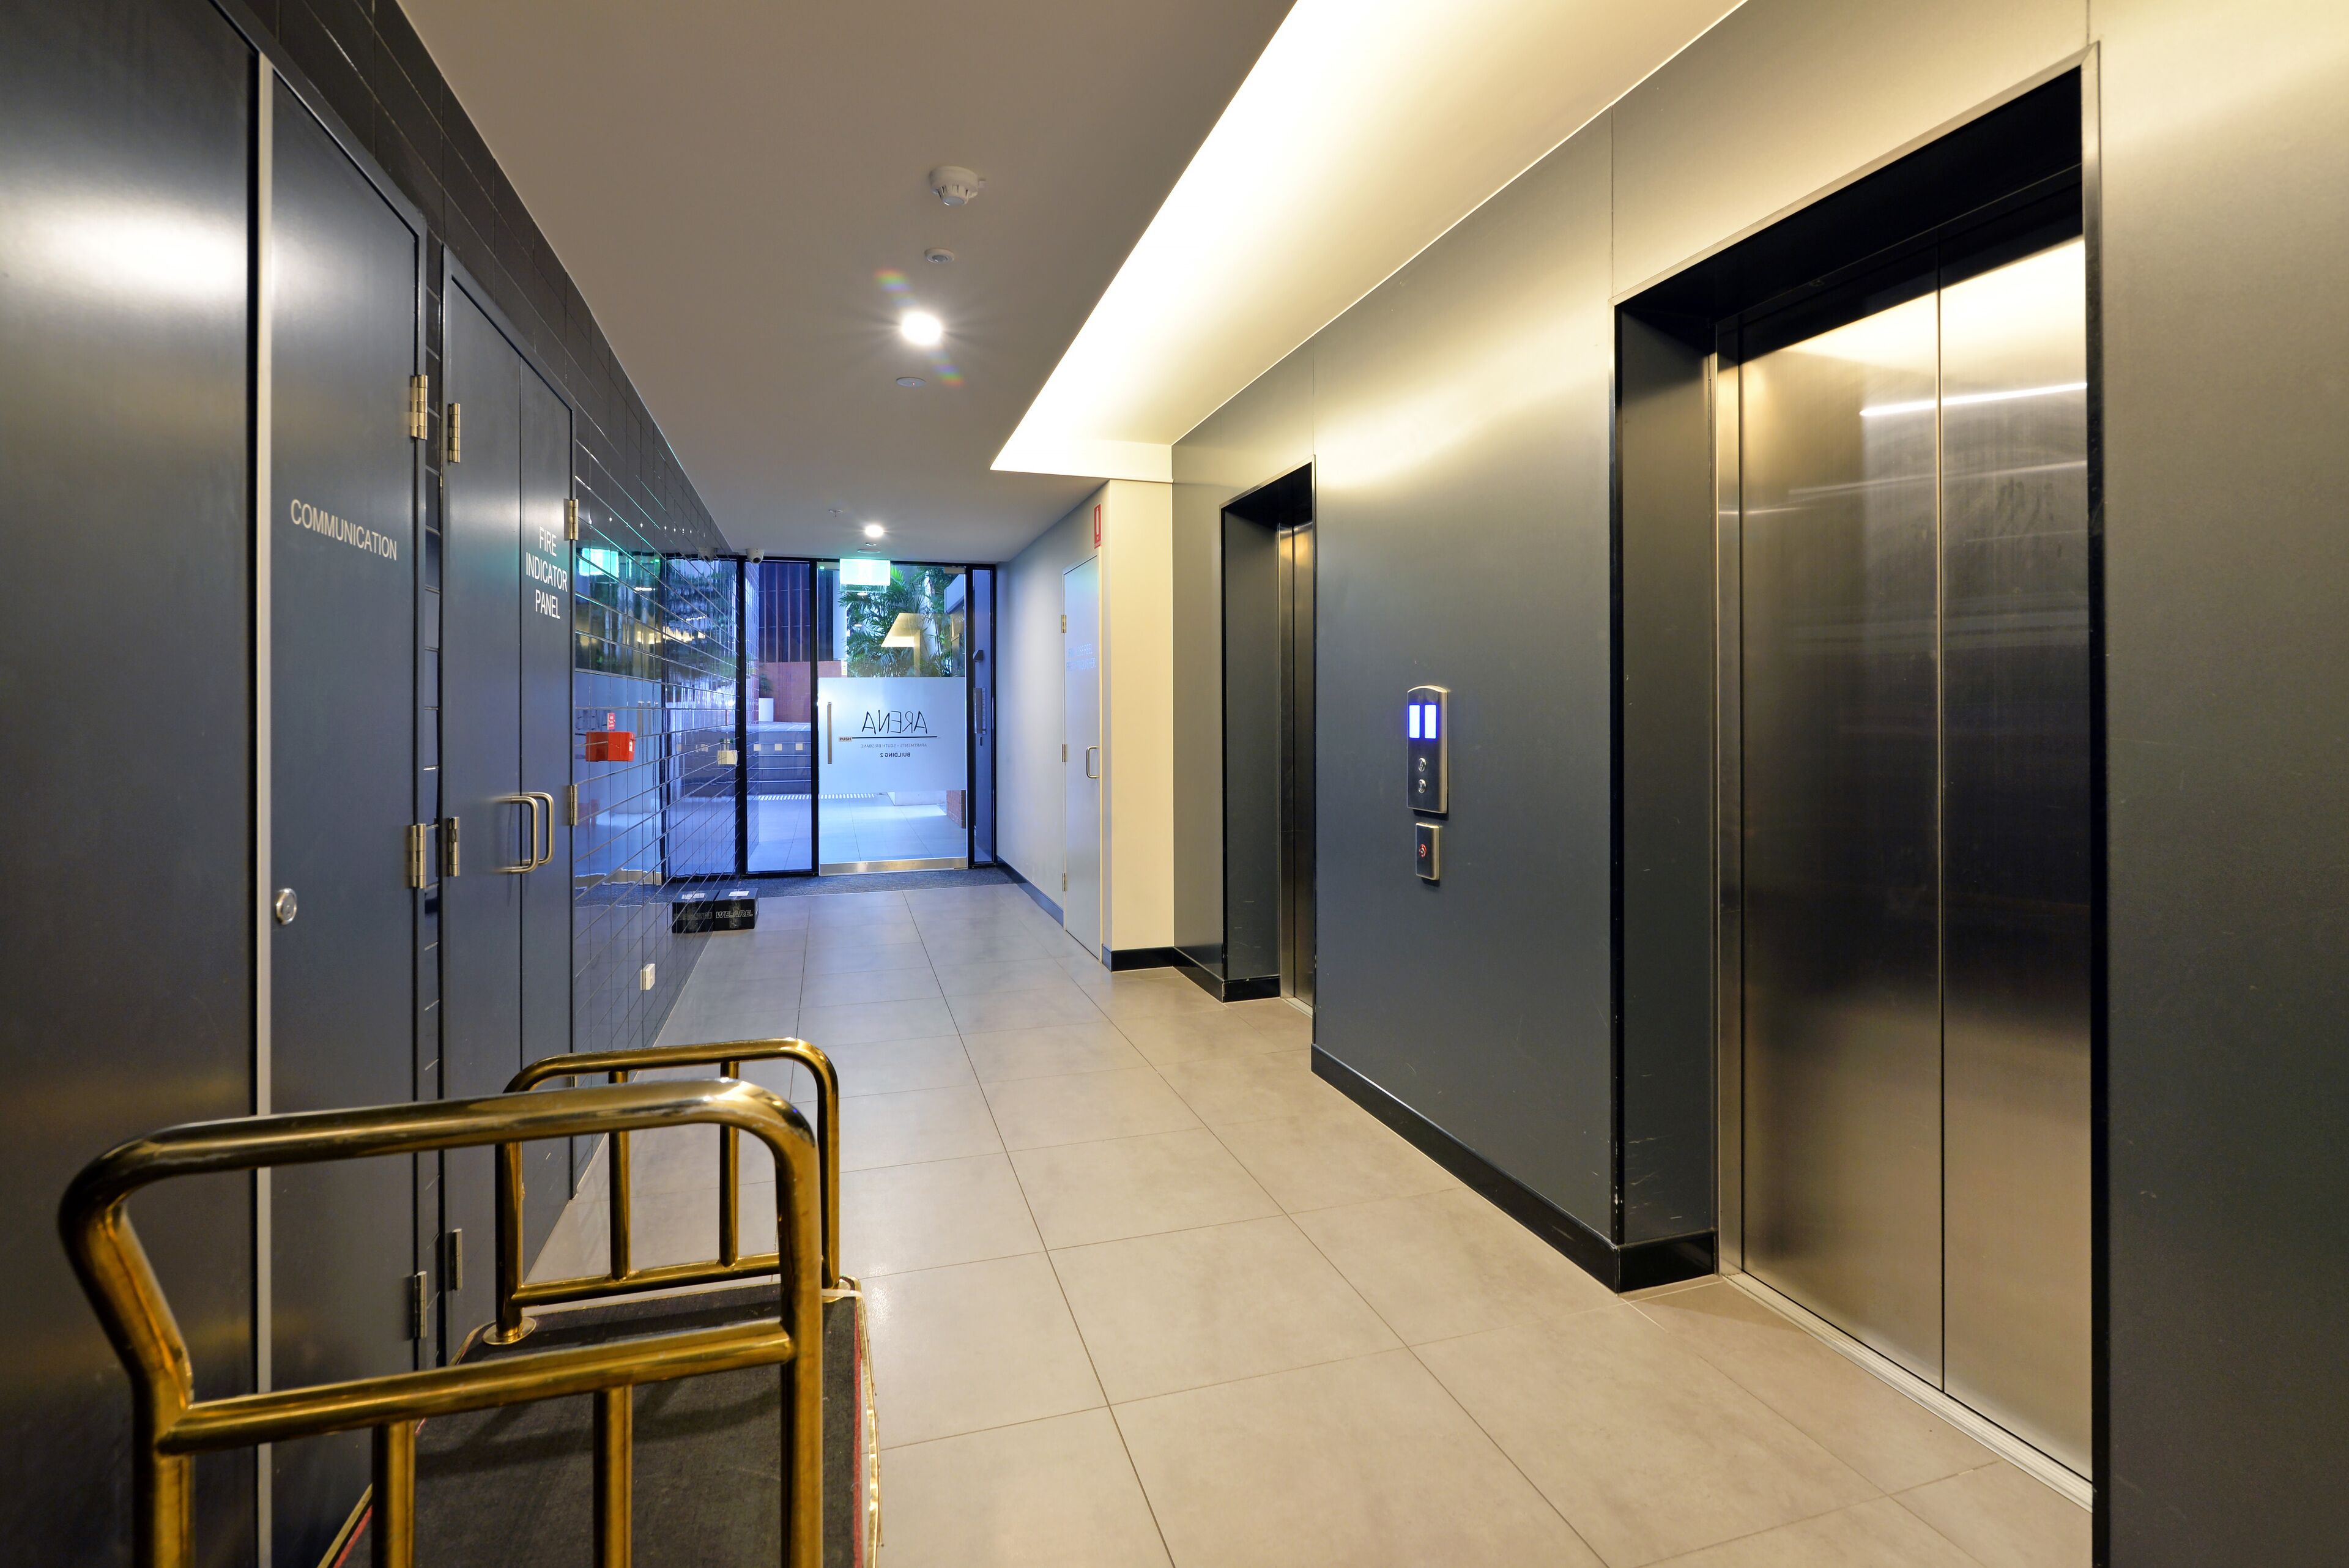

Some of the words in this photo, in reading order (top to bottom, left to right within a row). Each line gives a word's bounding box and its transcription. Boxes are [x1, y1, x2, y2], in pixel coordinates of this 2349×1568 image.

[291, 499, 397, 560] COMMUNICATION
[539, 526, 557, 557] FIRE
[526, 552, 568, 592] INDICATOR
[535, 589, 560, 619] PANEL
